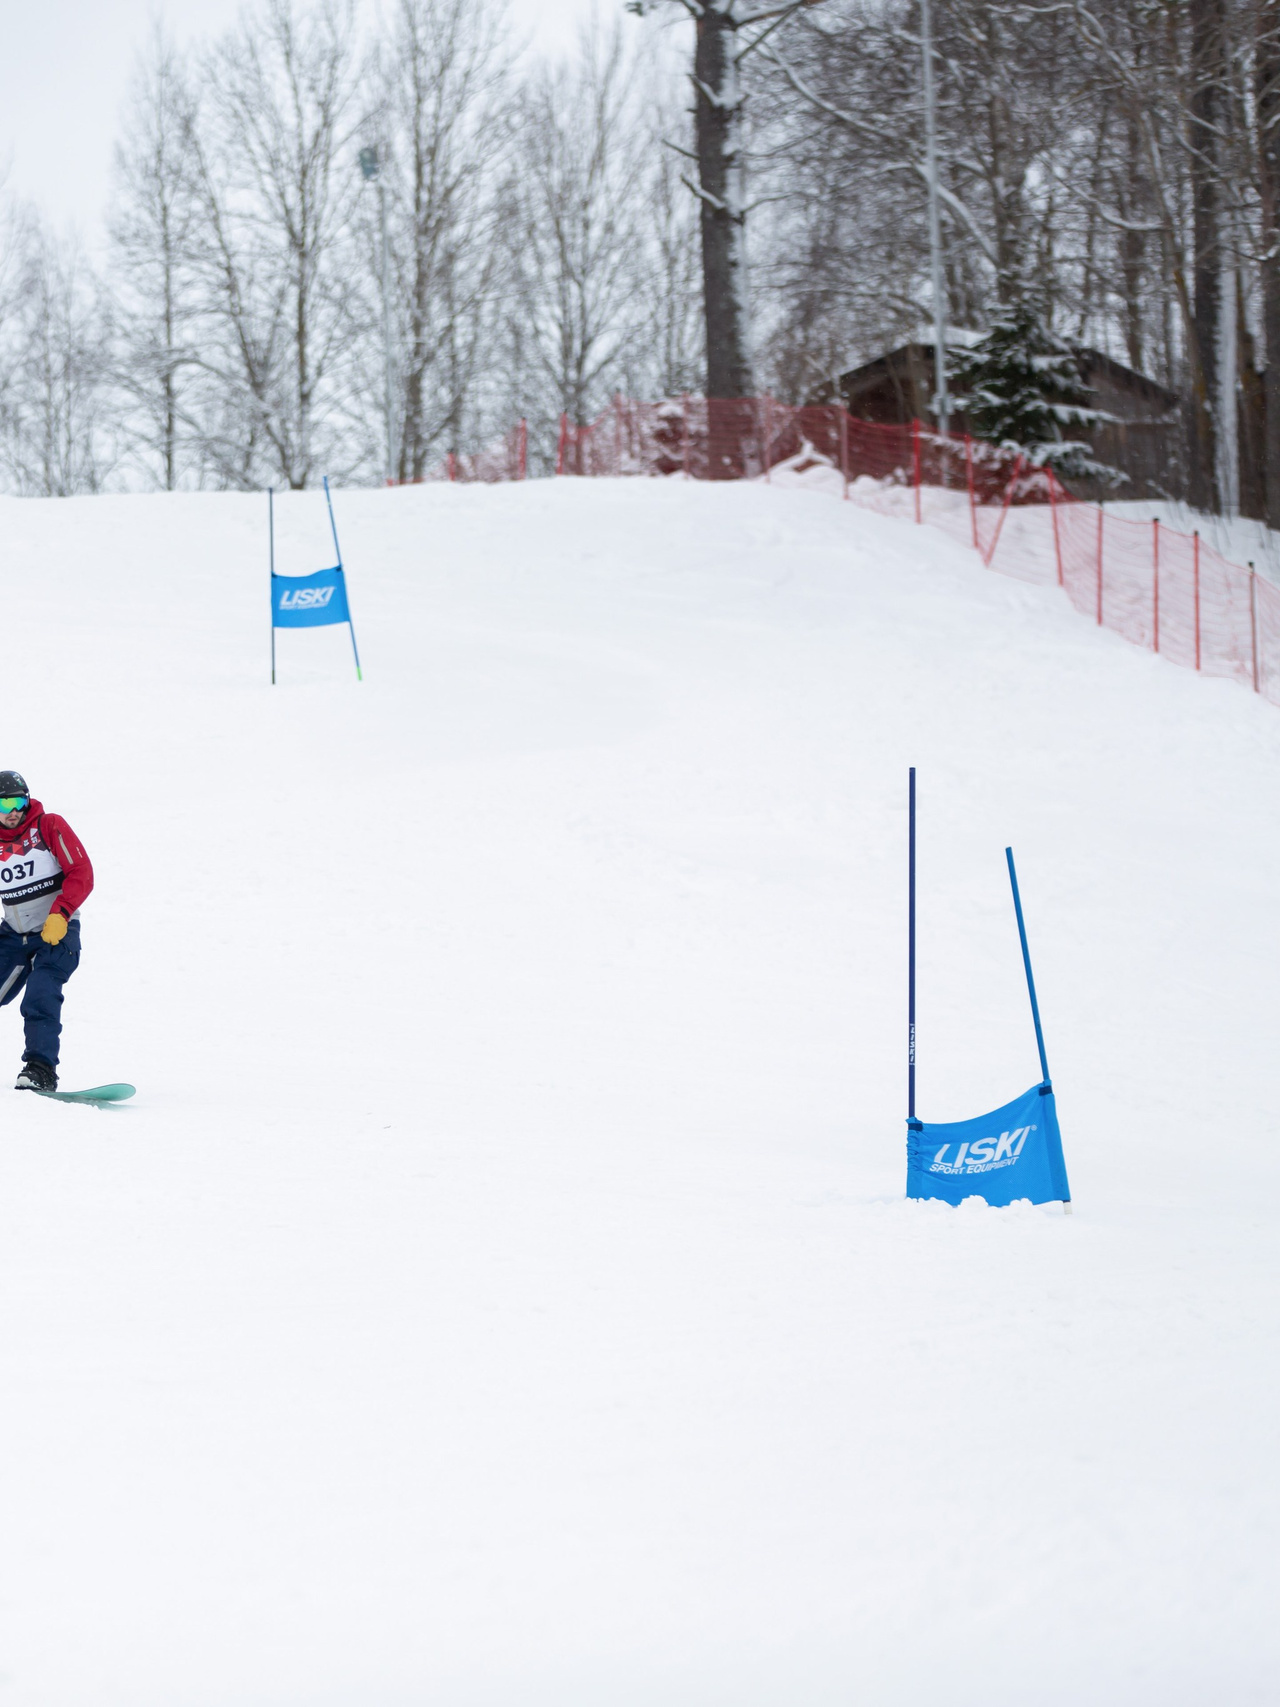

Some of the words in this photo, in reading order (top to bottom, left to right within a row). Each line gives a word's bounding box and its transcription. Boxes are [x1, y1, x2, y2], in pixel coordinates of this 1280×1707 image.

[280, 586, 335, 605] LISKI
[0, 860, 35, 884] 037
[933, 1125, 1031, 1169] LISKI
[929, 1163, 965, 1175] SPORT
[966, 1156, 1020, 1174] EQUIPMENT
